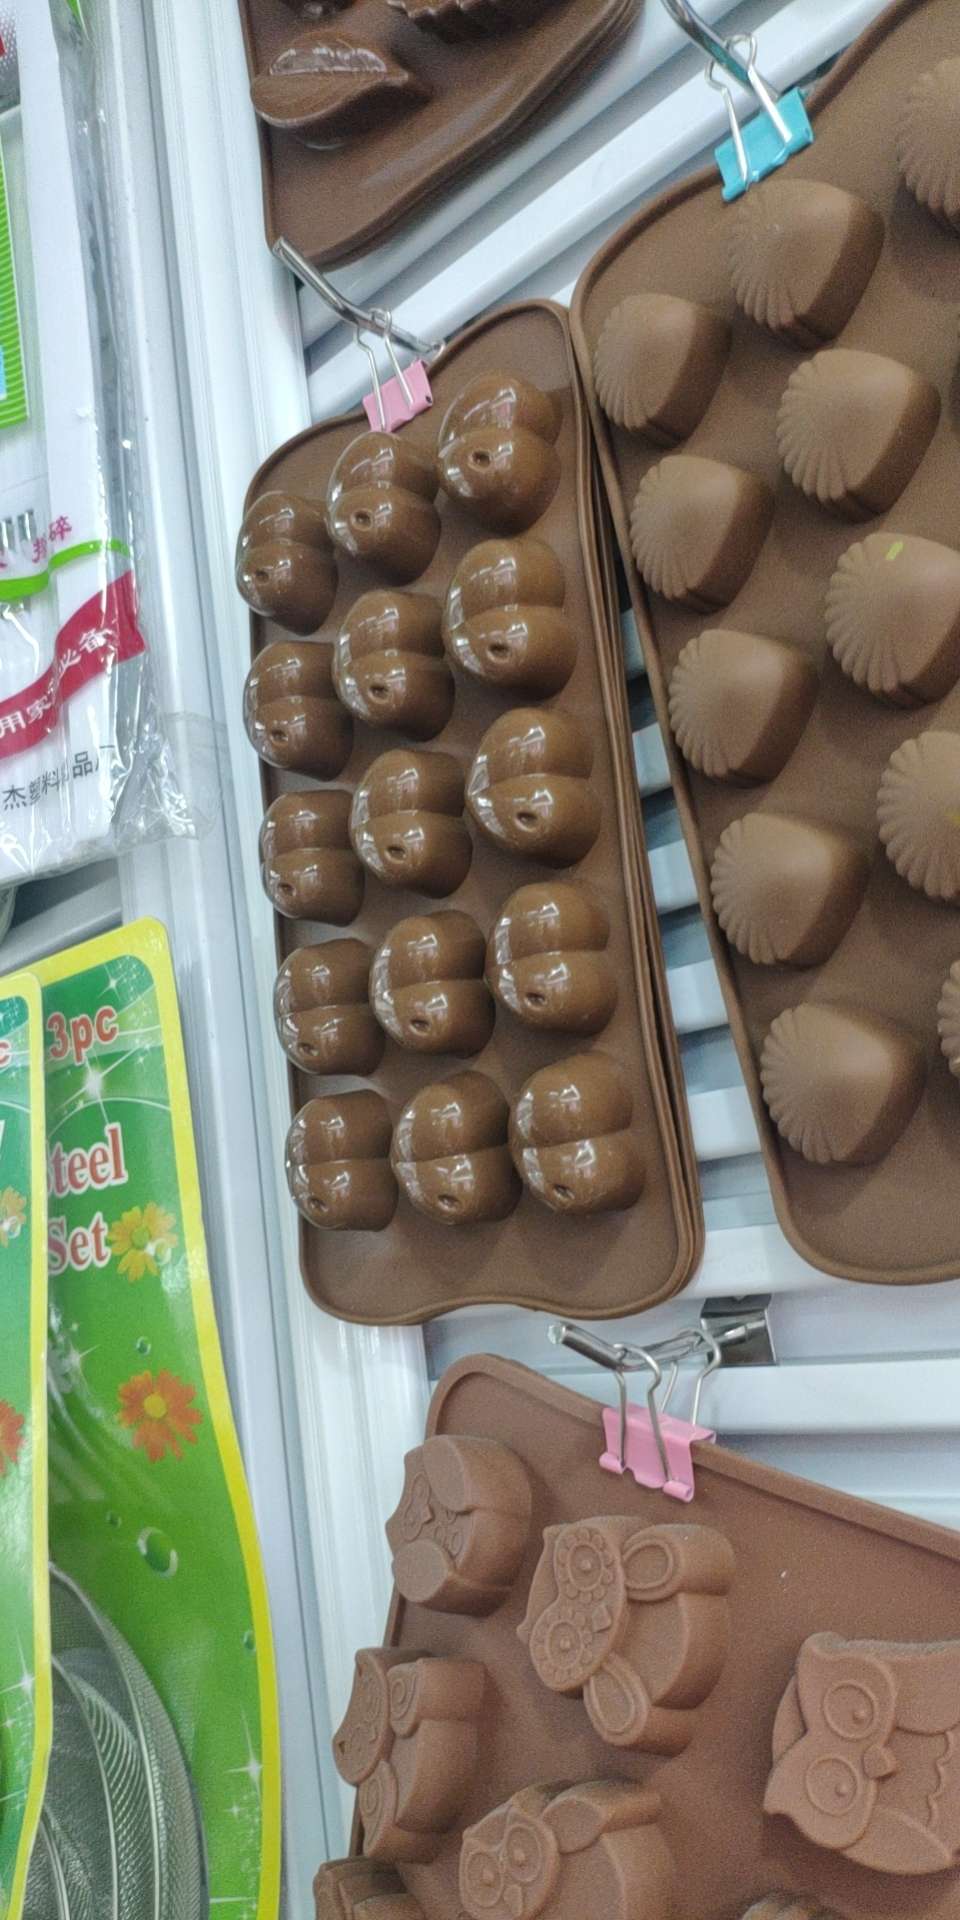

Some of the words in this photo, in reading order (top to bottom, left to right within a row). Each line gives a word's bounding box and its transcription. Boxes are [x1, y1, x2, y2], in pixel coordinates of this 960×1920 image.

[2, 745, 115, 811] 杰塑料品厂
[48, 1005, 118, 1064] 3pc
[47, 1122, 128, 1197] teel
[48, 1212, 110, 1274] Set
